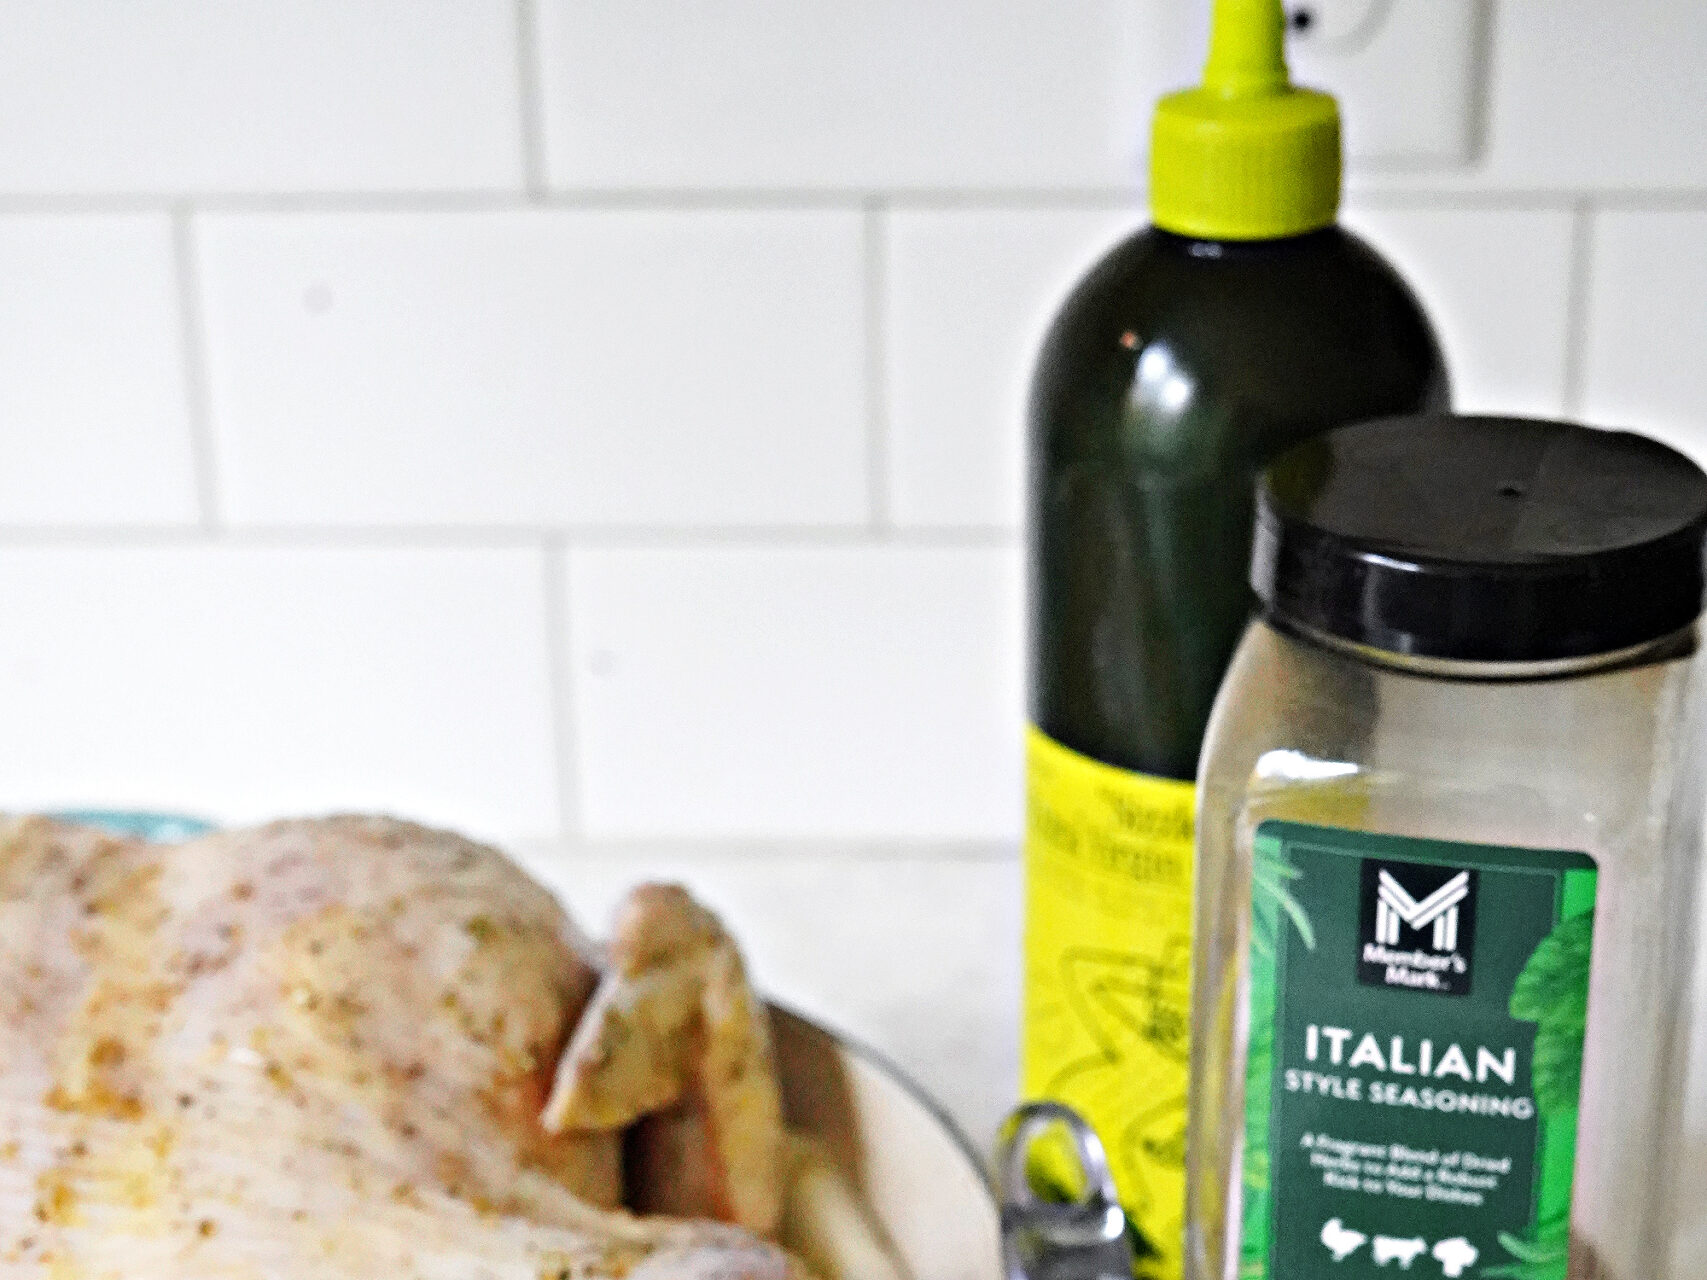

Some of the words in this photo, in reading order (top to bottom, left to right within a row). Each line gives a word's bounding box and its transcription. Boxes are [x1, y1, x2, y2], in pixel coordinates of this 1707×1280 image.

[1305, 1023, 1516, 1085] ITALIAN
[1284, 1068, 1362, 1101] STYLE
[1368, 1081, 1535, 1120] SEASONING
